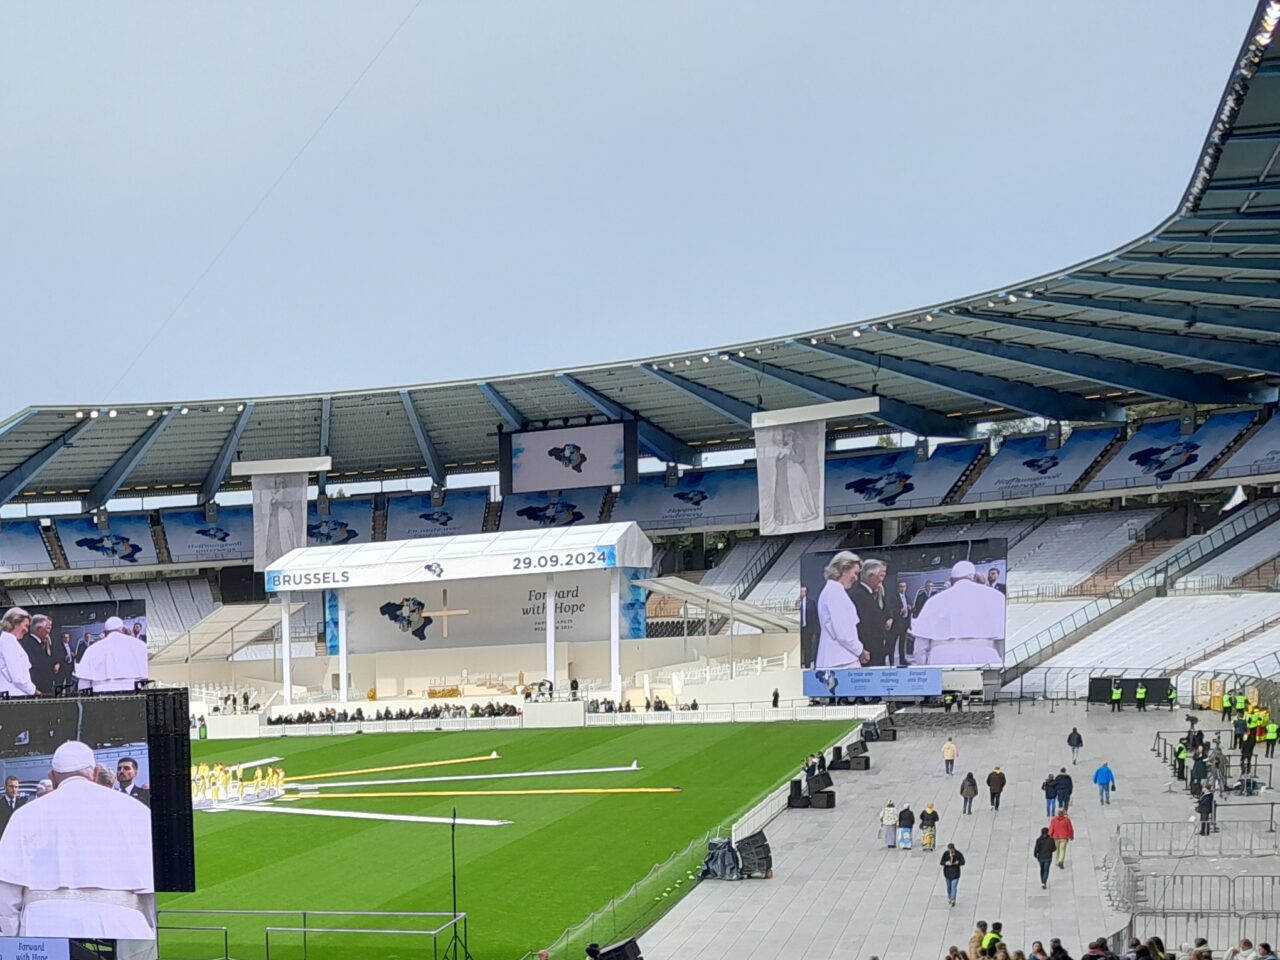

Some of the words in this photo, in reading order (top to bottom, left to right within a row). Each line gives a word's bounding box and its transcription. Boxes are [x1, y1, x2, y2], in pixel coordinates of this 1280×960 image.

[513, 551, 606, 570] 29.09.2024
[272, 571, 350, 587] BRUSSELS
[528, 586, 579, 602] Forard
[554, 601, 586, 617] Hope
[18, 942, 45, 952] Forward
